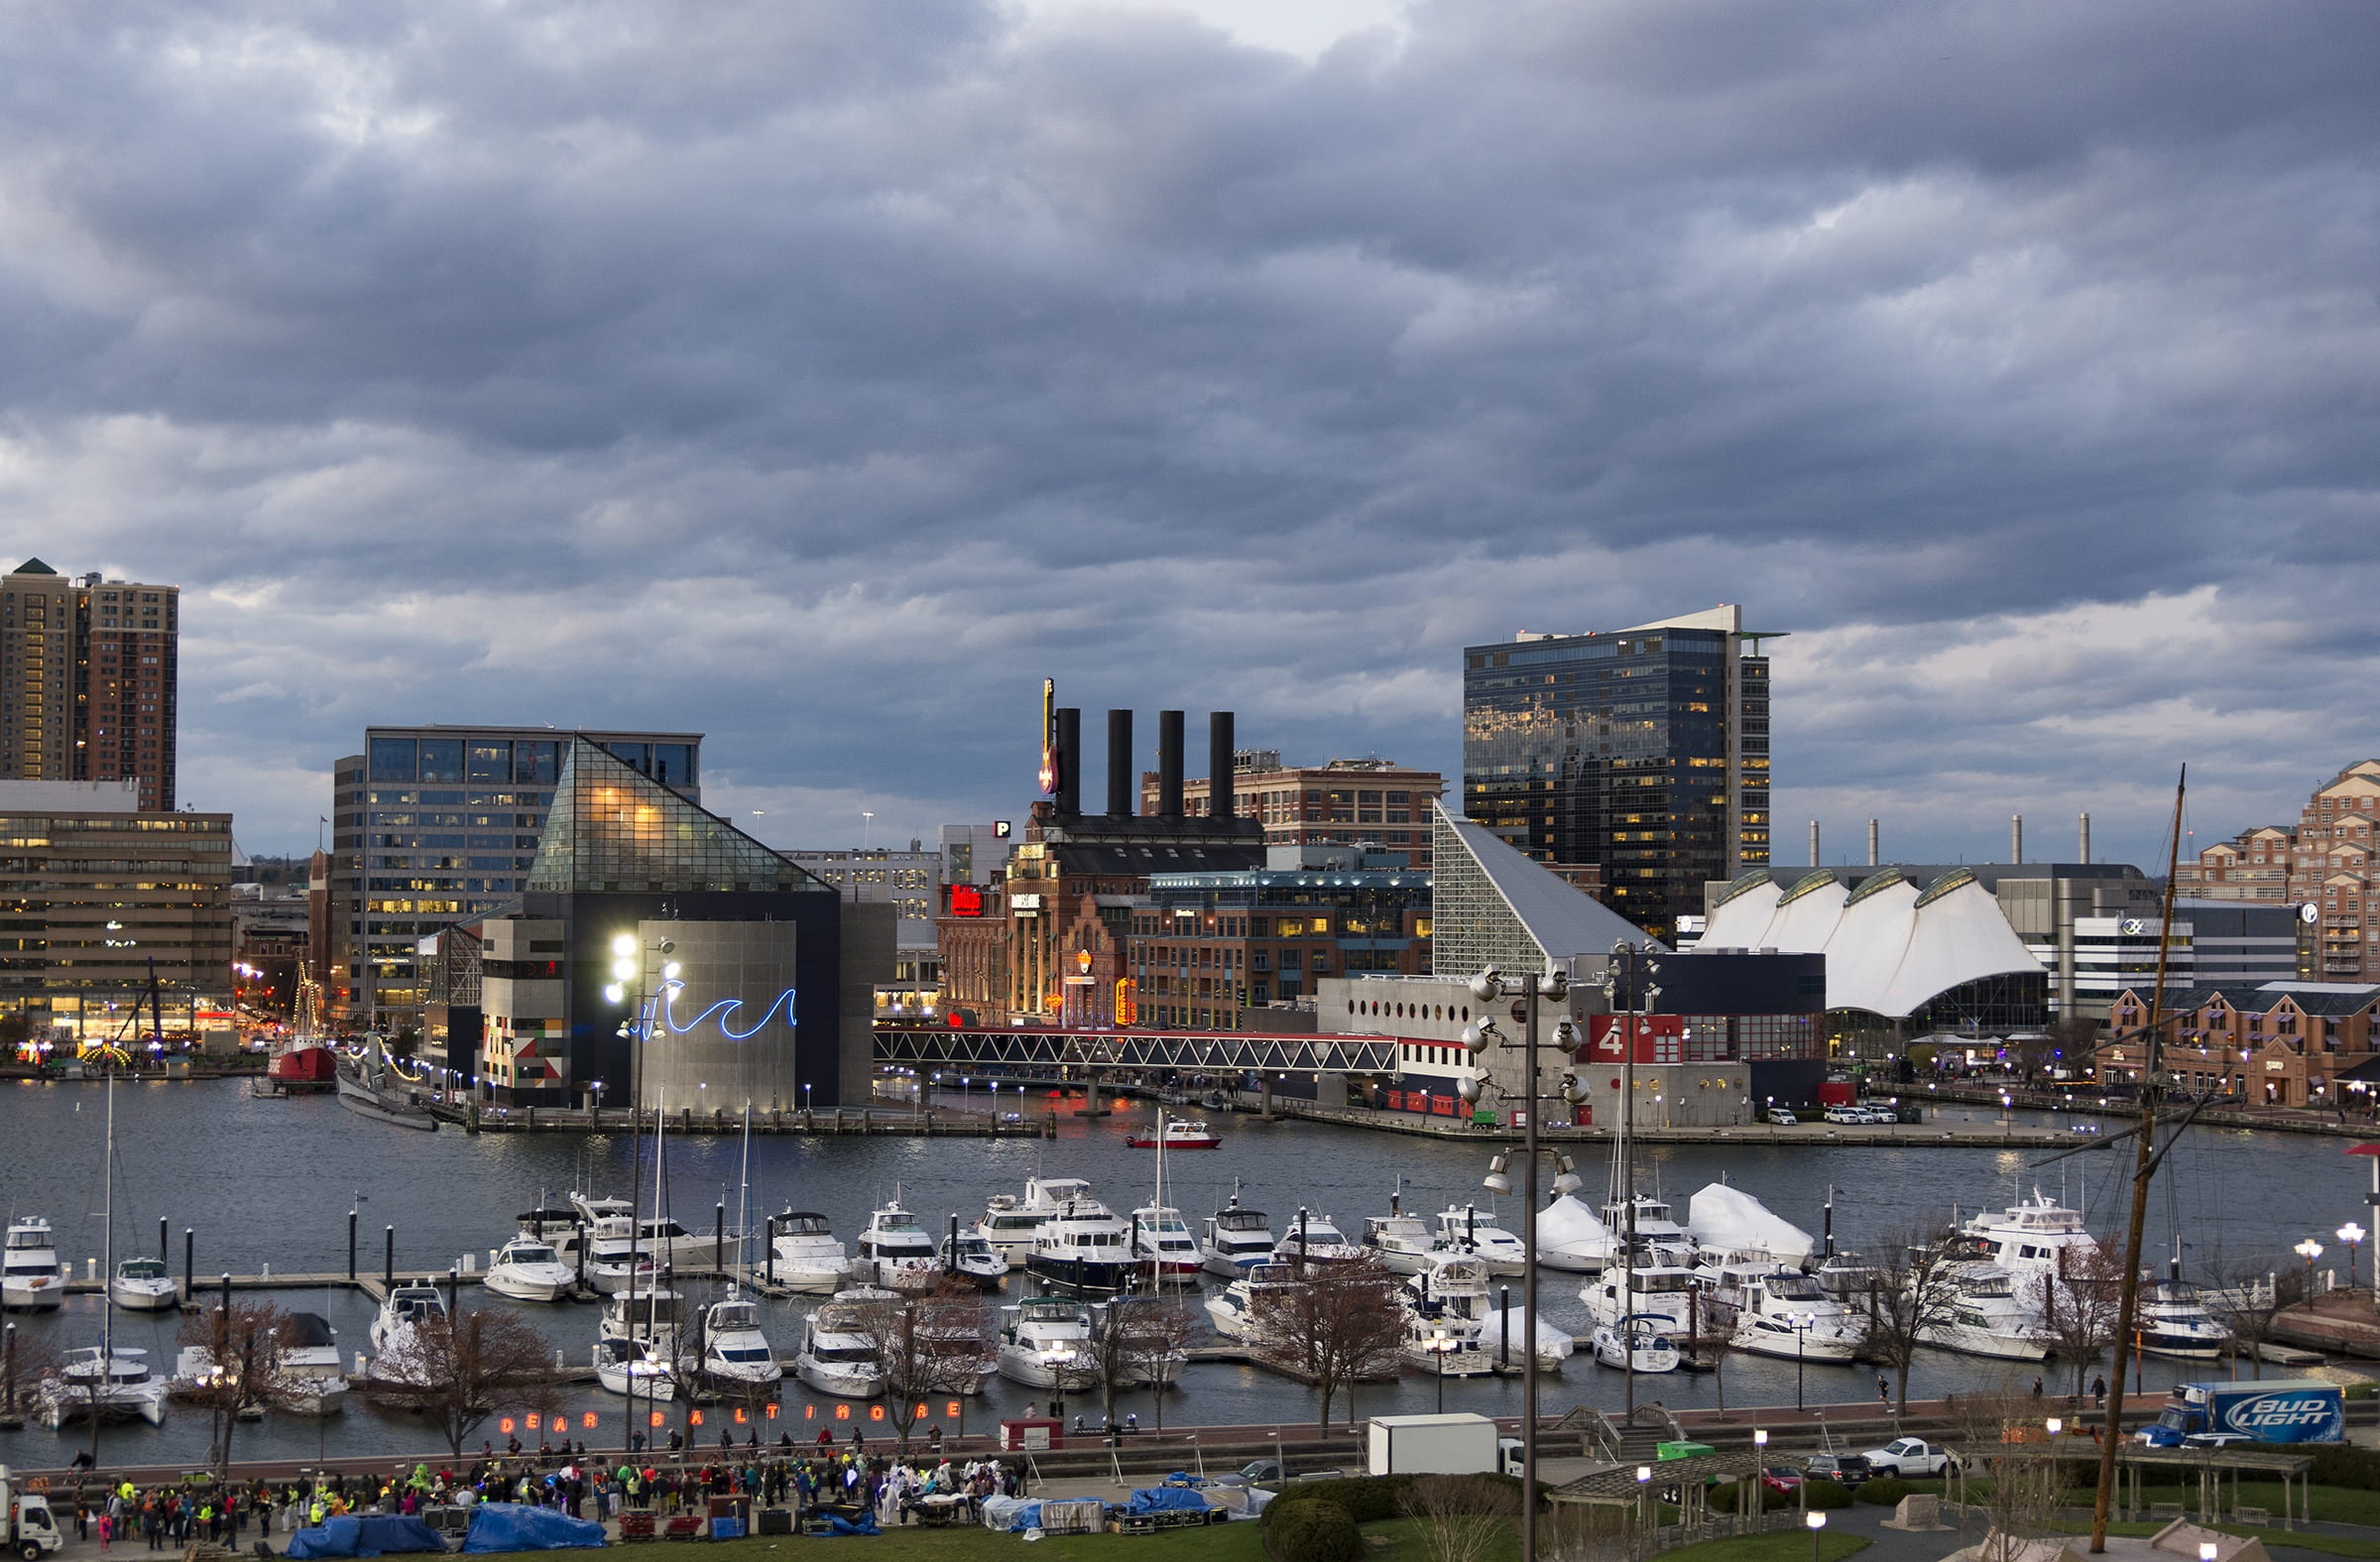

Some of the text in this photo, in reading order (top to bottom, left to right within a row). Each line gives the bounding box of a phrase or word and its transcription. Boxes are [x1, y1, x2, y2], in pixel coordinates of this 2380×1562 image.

[997, 822, 1010, 837] P
[1599, 1028, 1623, 1055] 4
[2251, 1399, 2326, 1413] BUD
[500, 1401, 960, 1434] DEAR BALTIMORE
[2234, 1412, 2331, 1426] LIGHT
